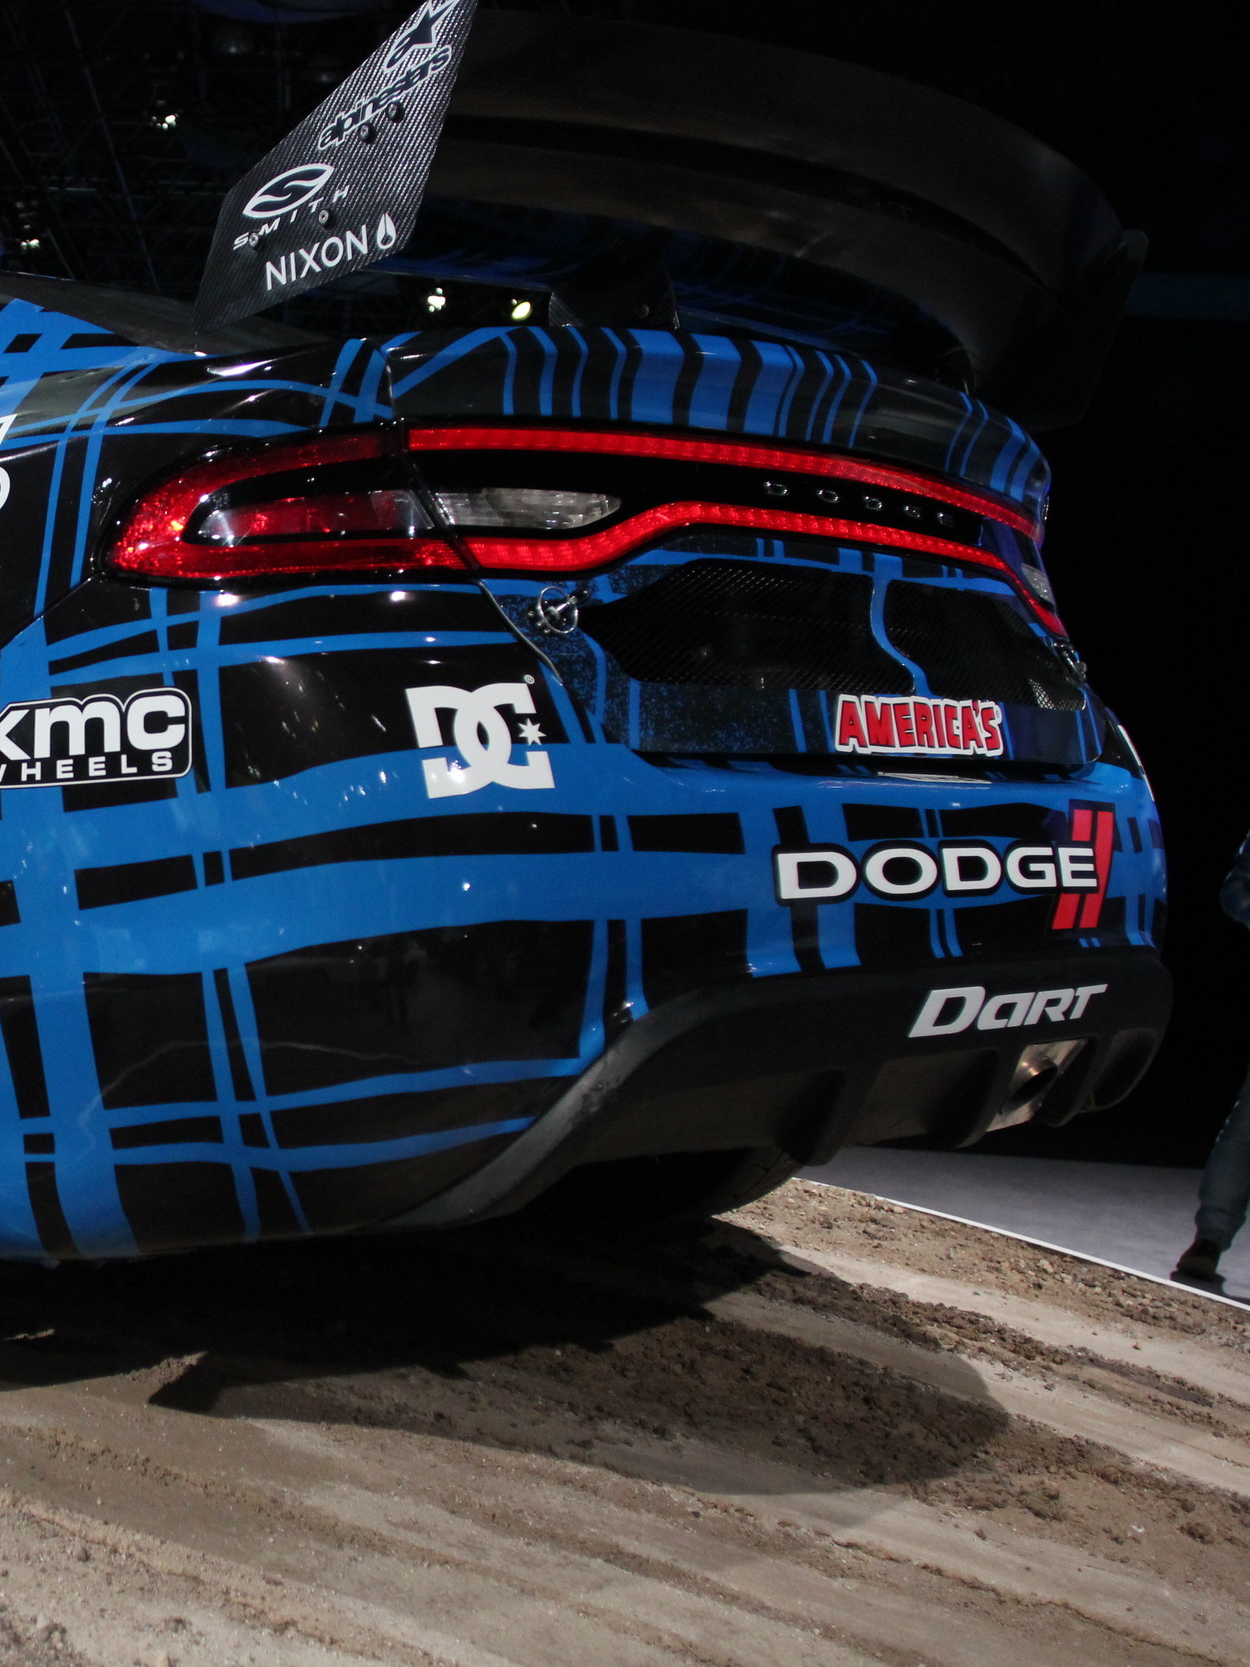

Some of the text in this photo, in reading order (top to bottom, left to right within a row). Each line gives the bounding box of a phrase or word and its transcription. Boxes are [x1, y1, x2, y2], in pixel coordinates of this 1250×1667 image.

[233, 185, 350, 250] SMITH
[265, 225, 369, 291] NIXON
[764, 481, 953, 527] DODGE
[405, 682, 556, 799] DC
[836, 694, 1003, 757] AMERICA'S
[776, 846, 1098, 900] DODGE
